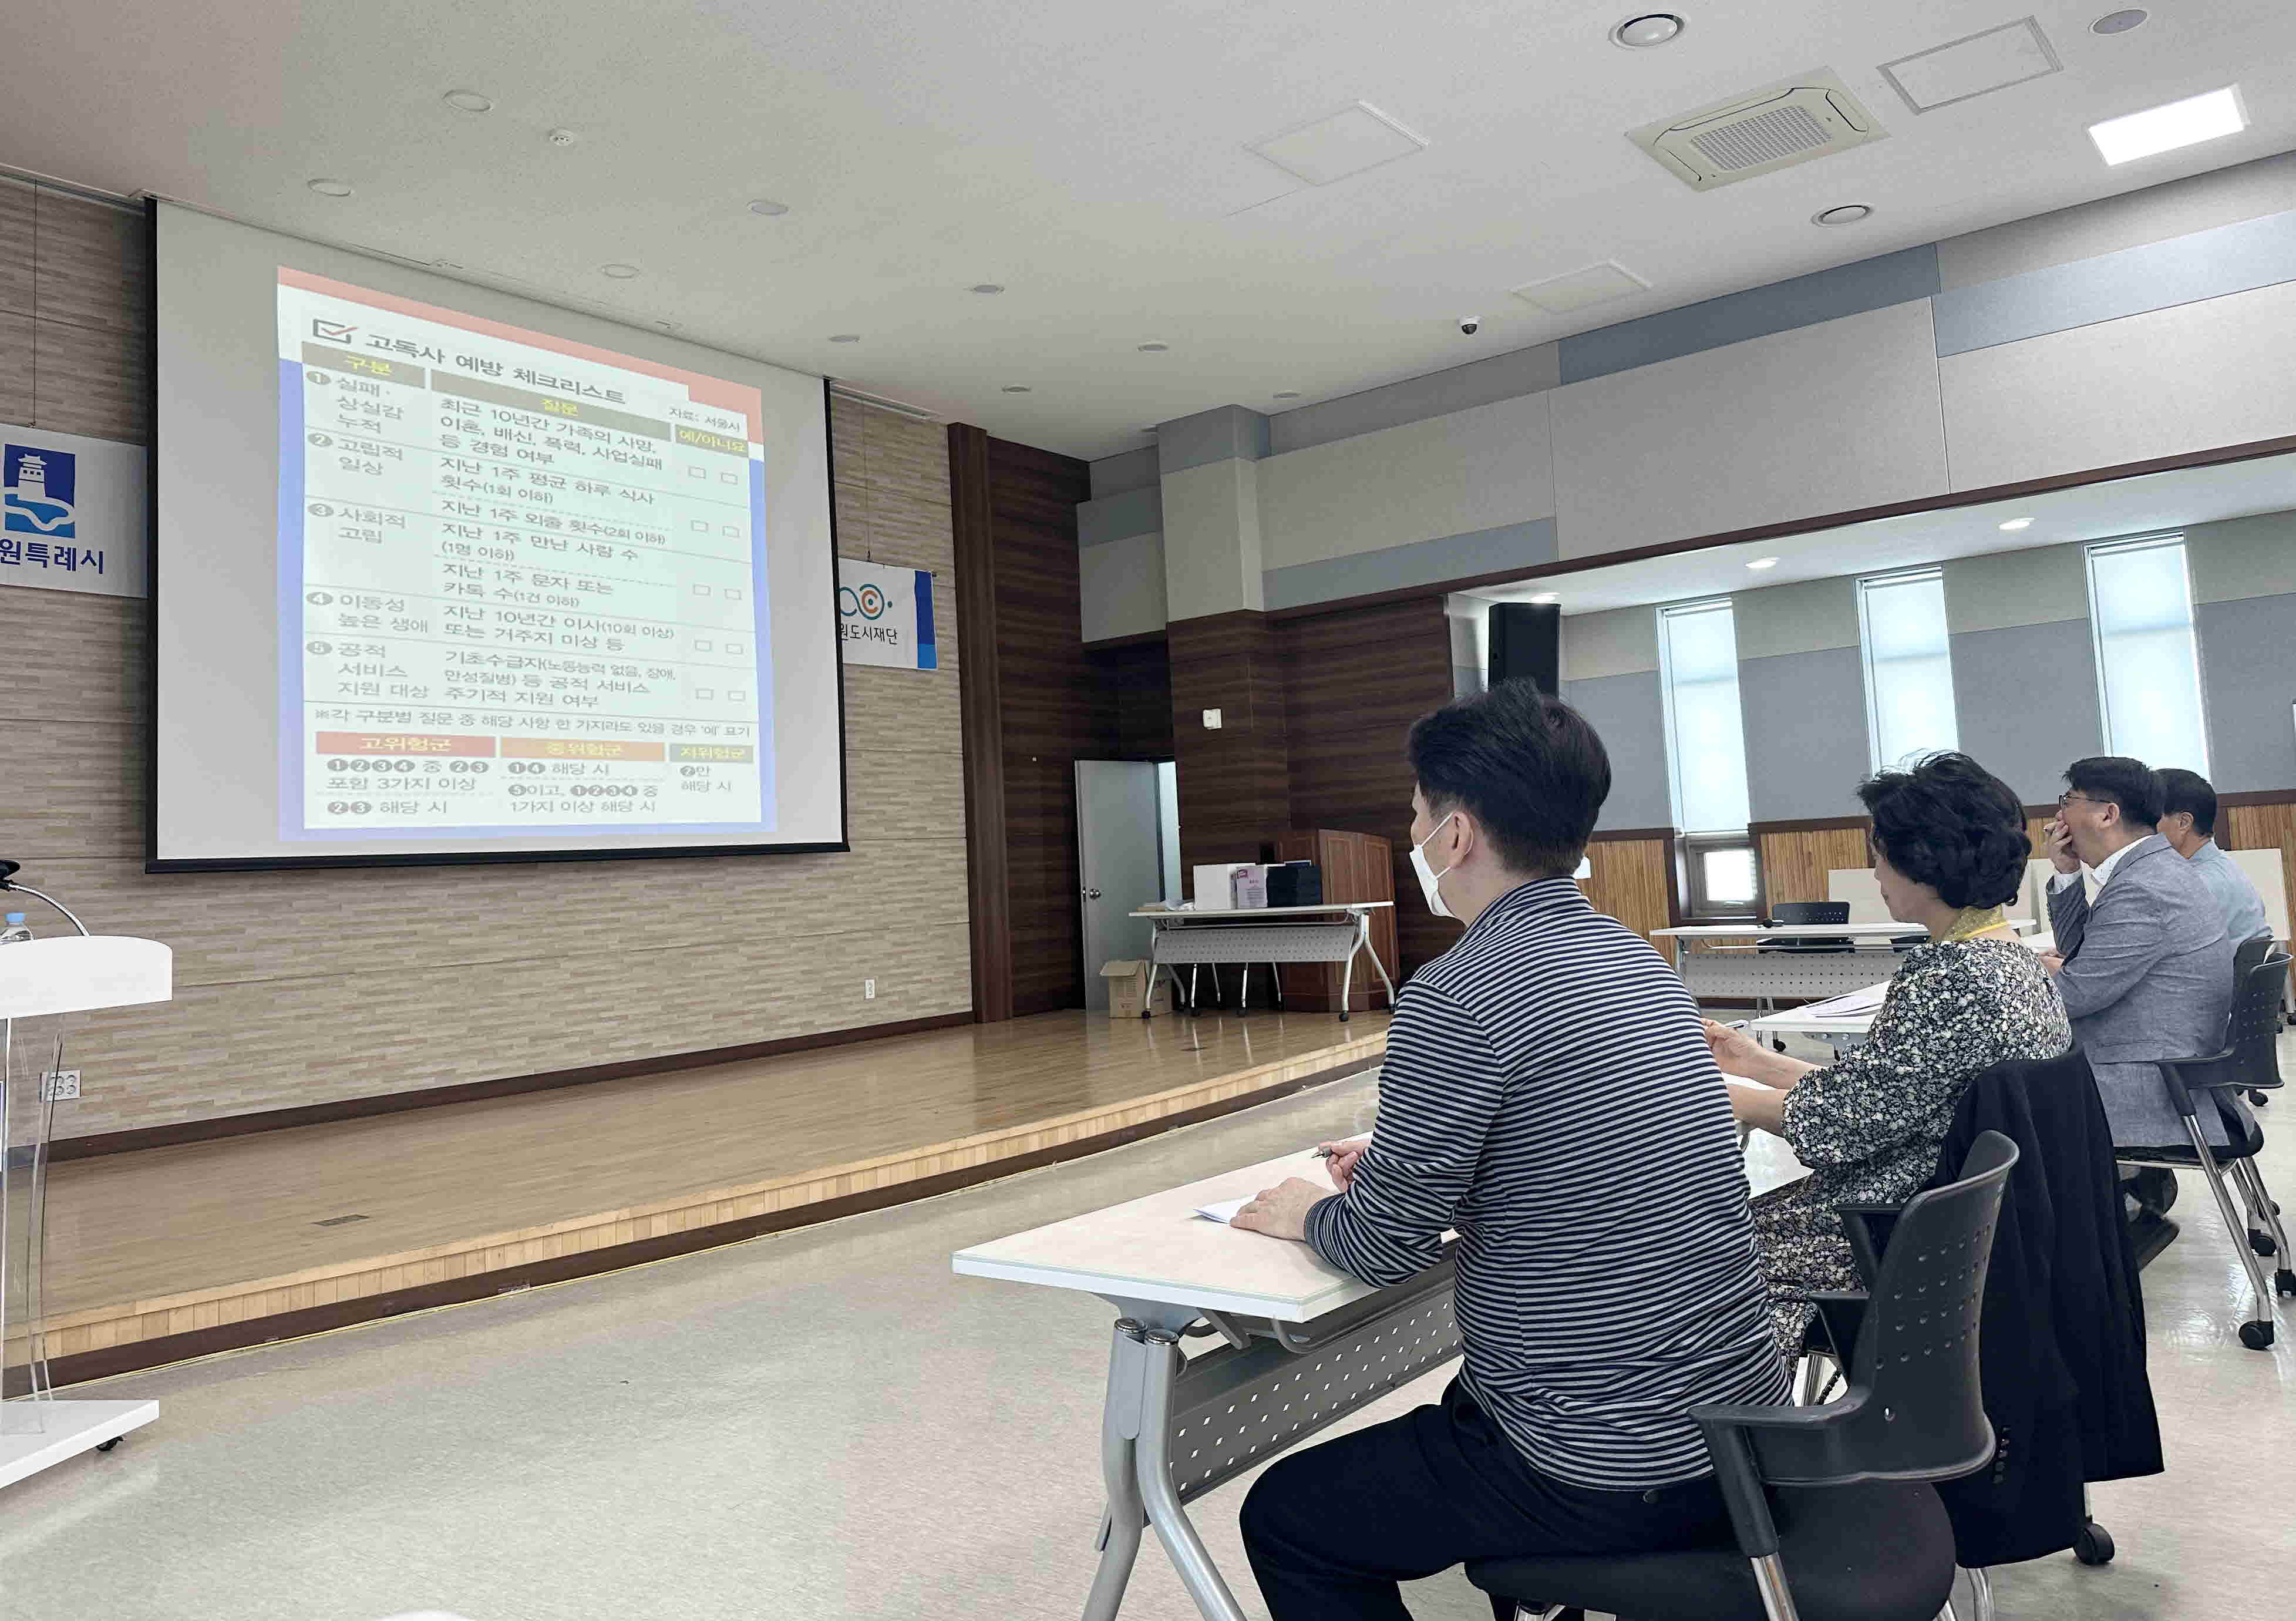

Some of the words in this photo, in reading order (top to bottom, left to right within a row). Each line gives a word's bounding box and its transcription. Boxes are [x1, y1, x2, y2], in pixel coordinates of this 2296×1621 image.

[366, 335, 445, 364] 고독사
[456, 355, 503, 376] 예방
[513, 368, 625, 404] 체크리스트
[336, 378, 380, 396] 실패
[338, 397, 404, 419] 상실감
[338, 414, 381, 433] 누적
[442, 398, 481, 416] 최근
[492, 408, 549, 431] 10년간
[556, 422, 611, 445] 가족의
[338, 439, 403, 461] 고립적
[440, 433, 462, 449] 등
[470, 439, 508, 457] 경험
[517, 450, 554, 465] 여부
[593, 446, 662, 470] 사업실패
[339, 457, 383, 476] 일상
[442, 458, 480, 475] 지난
[493, 467, 520, 480] 1주
[530, 473, 566, 489] 평균
[575, 482, 611, 496] 하루
[620, 488, 655, 505] 식사
[338, 508, 405, 529] 사회적
[442, 500, 480, 517] 지난
[490, 507, 518, 522] 1주
[338, 527, 382, 544] 고립
[442, 523, 483, 540] 지난
[494, 530, 521, 543] 1주
[531, 534, 568, 551] 만난
[577, 542, 613, 559] 사람
[620, 549, 639, 561] 수
[0, 539, 103, 574] 원특례시
[443, 563, 484, 580] 지난
[494, 570, 522, 584] 1주
[532, 574, 569, 590] 문자
[577, 579, 613, 596] 또는
[443, 583, 484, 598] 카톡
[339, 594, 405, 612] 이동성
[338, 613, 381, 629] 높은
[390, 617, 427, 633] 생애
[443, 606, 484, 621] 지난
[496, 611, 556, 628] 10년간
[445, 623, 485, 638] 또는
[494, 627, 553, 645] 거주지
[561, 634, 597, 650] 미상
[606, 638, 625, 651] 등
[338, 643, 386, 658] 공적
[338, 662, 408, 678] 서비스
[338, 682, 381, 697] 지원
[390, 684, 429, 699] 대상
[524, 675, 543, 687] 등
[550, 677, 588, 691] 공적
[597, 680, 651, 694] 서비스
[446, 687, 506, 702] 주기적
[516, 691, 554, 705] 지원
[563, 695, 600, 708] 여부
[418, 711, 454, 725] 질문
[482, 714, 513, 728] 해당
[520, 717, 550, 729] 사항
[577, 720, 633, 732] 가지라도
[671, 724, 696, 736] 경우
[723, 726, 750, 738] 표기
[359, 737, 452, 752] 고위험군
[552, 762, 586, 775] 해당
[594, 764, 609, 775] 시
[327, 778, 369, 791] 포함
[378, 778, 430, 791] 3가지
[439, 778, 476, 791] 이상
[681, 780, 712, 793] 해당
[716, 781, 732, 791] 시
[380, 801, 420, 815] 해당
[427, 801, 447, 814] 시
[511, 801, 554, 813] 1가지
[561, 801, 594, 813] 이상
[601, 801, 633, 813] 해당
[639, 801, 656, 813] 시
